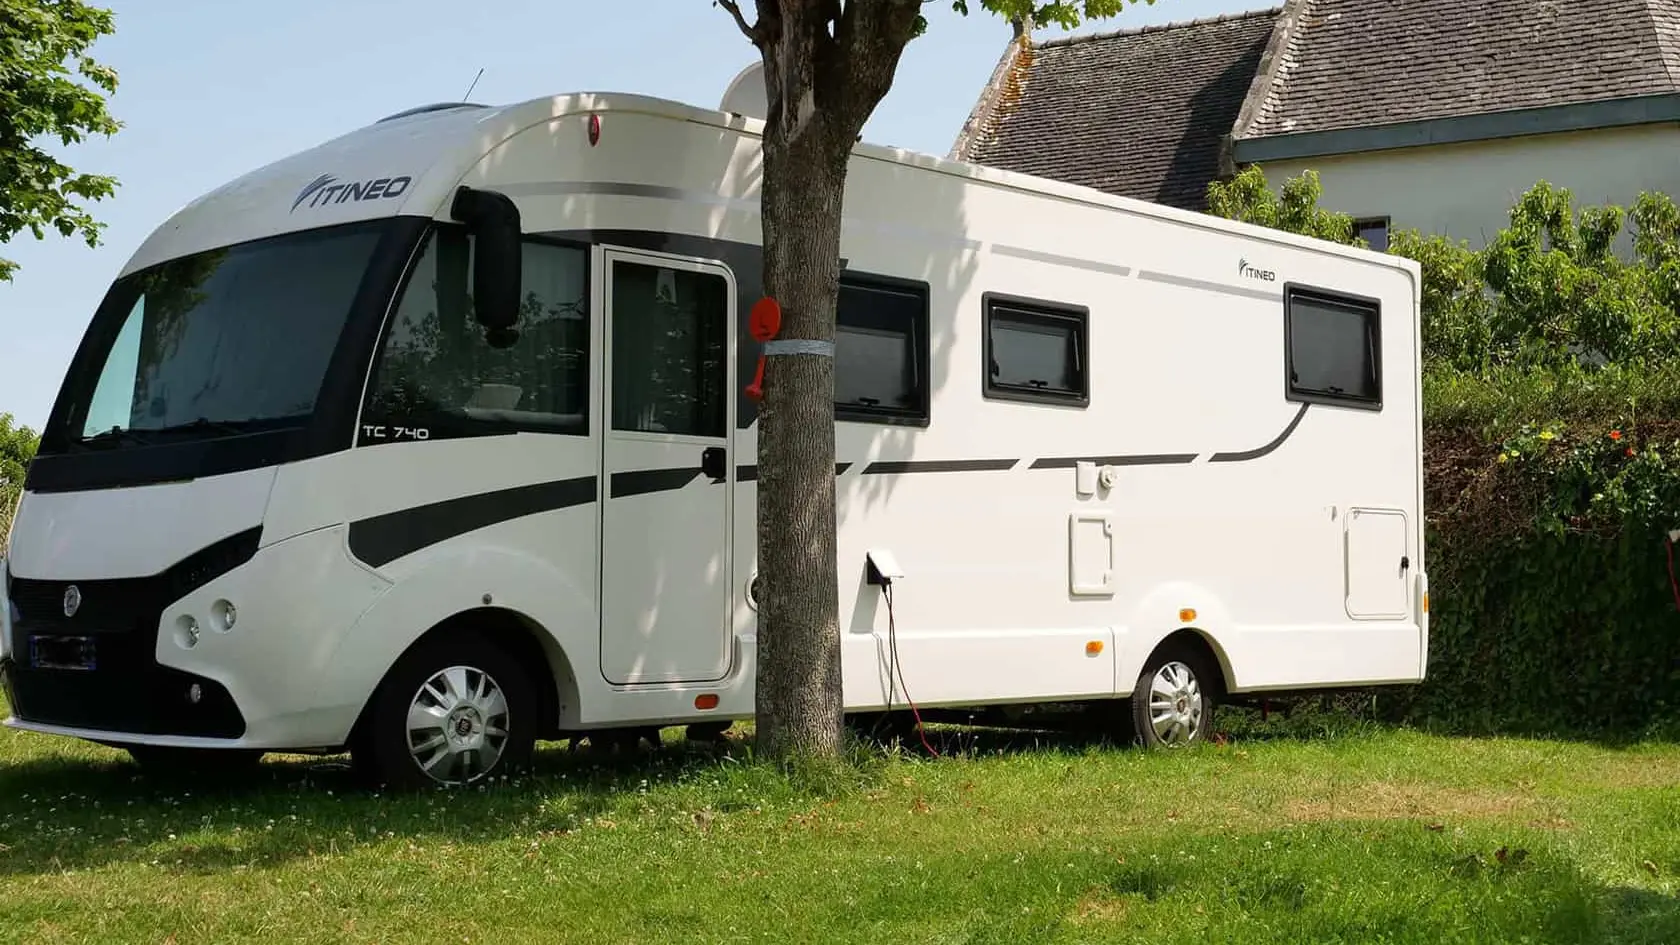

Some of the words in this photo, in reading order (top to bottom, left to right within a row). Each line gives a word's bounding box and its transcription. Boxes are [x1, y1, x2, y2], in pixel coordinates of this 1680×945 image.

[309, 176, 412, 208] ITINEO
[1246, 266, 1275, 281] ITINEO
[363, 425, 386, 437] TC
[393, 426, 429, 439] 740
